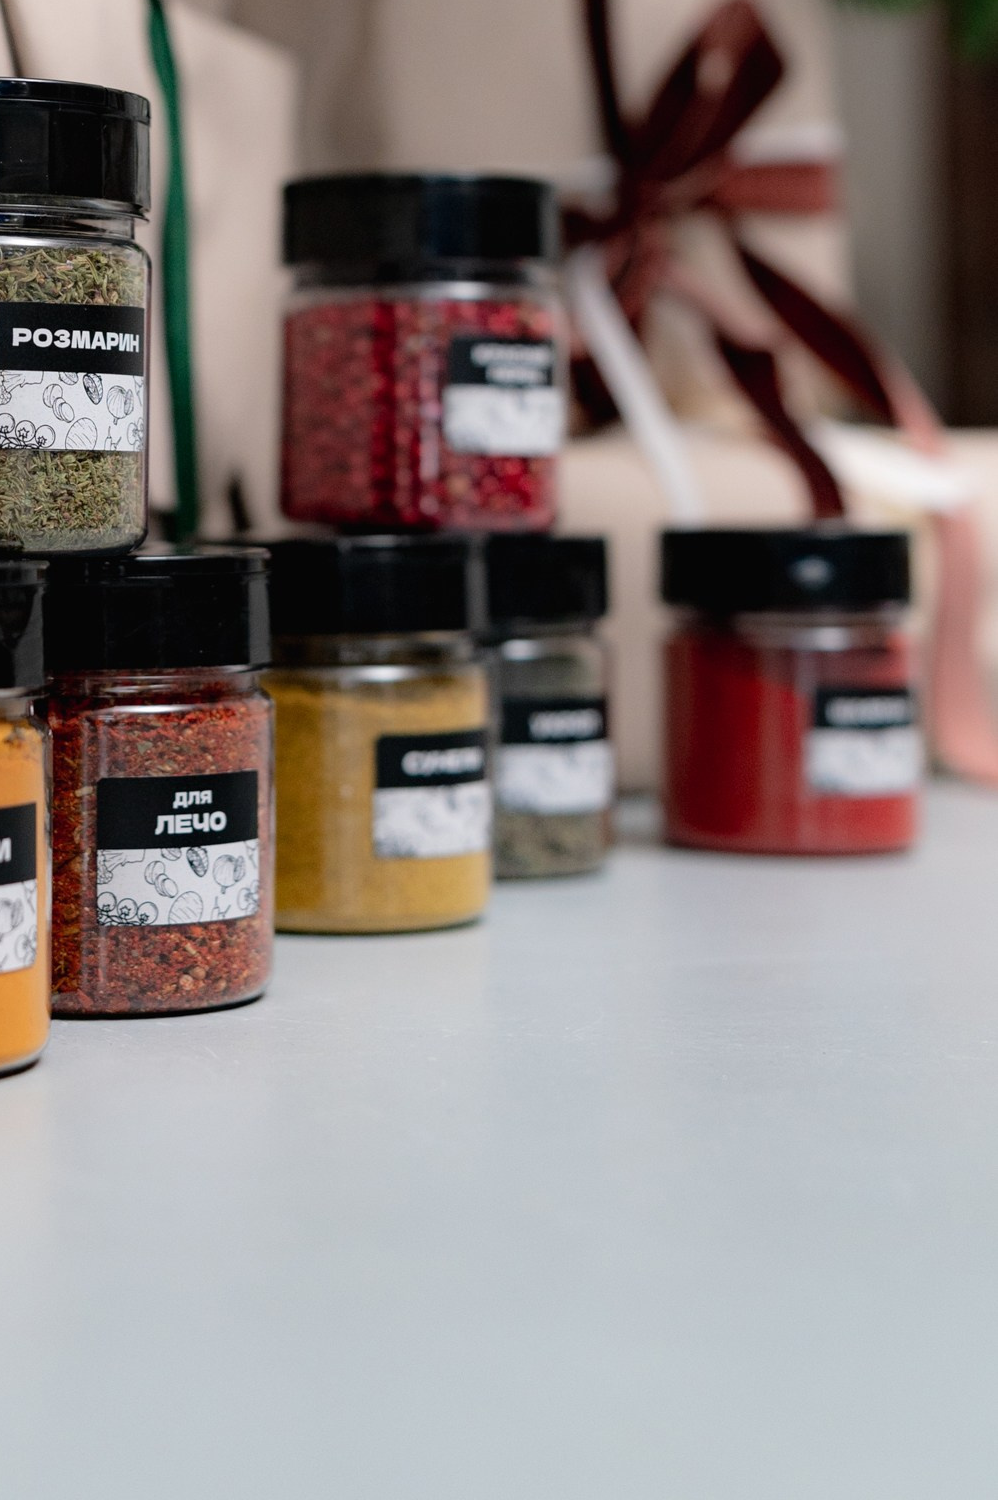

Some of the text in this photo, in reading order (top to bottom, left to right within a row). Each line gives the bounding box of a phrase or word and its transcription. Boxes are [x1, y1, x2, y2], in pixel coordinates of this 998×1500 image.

[12, 327, 140, 352] РОЗМАРИН
[173, 790, 212, 809] ДЛЯ
[155, 811, 226, 835] ЛЕЧО
